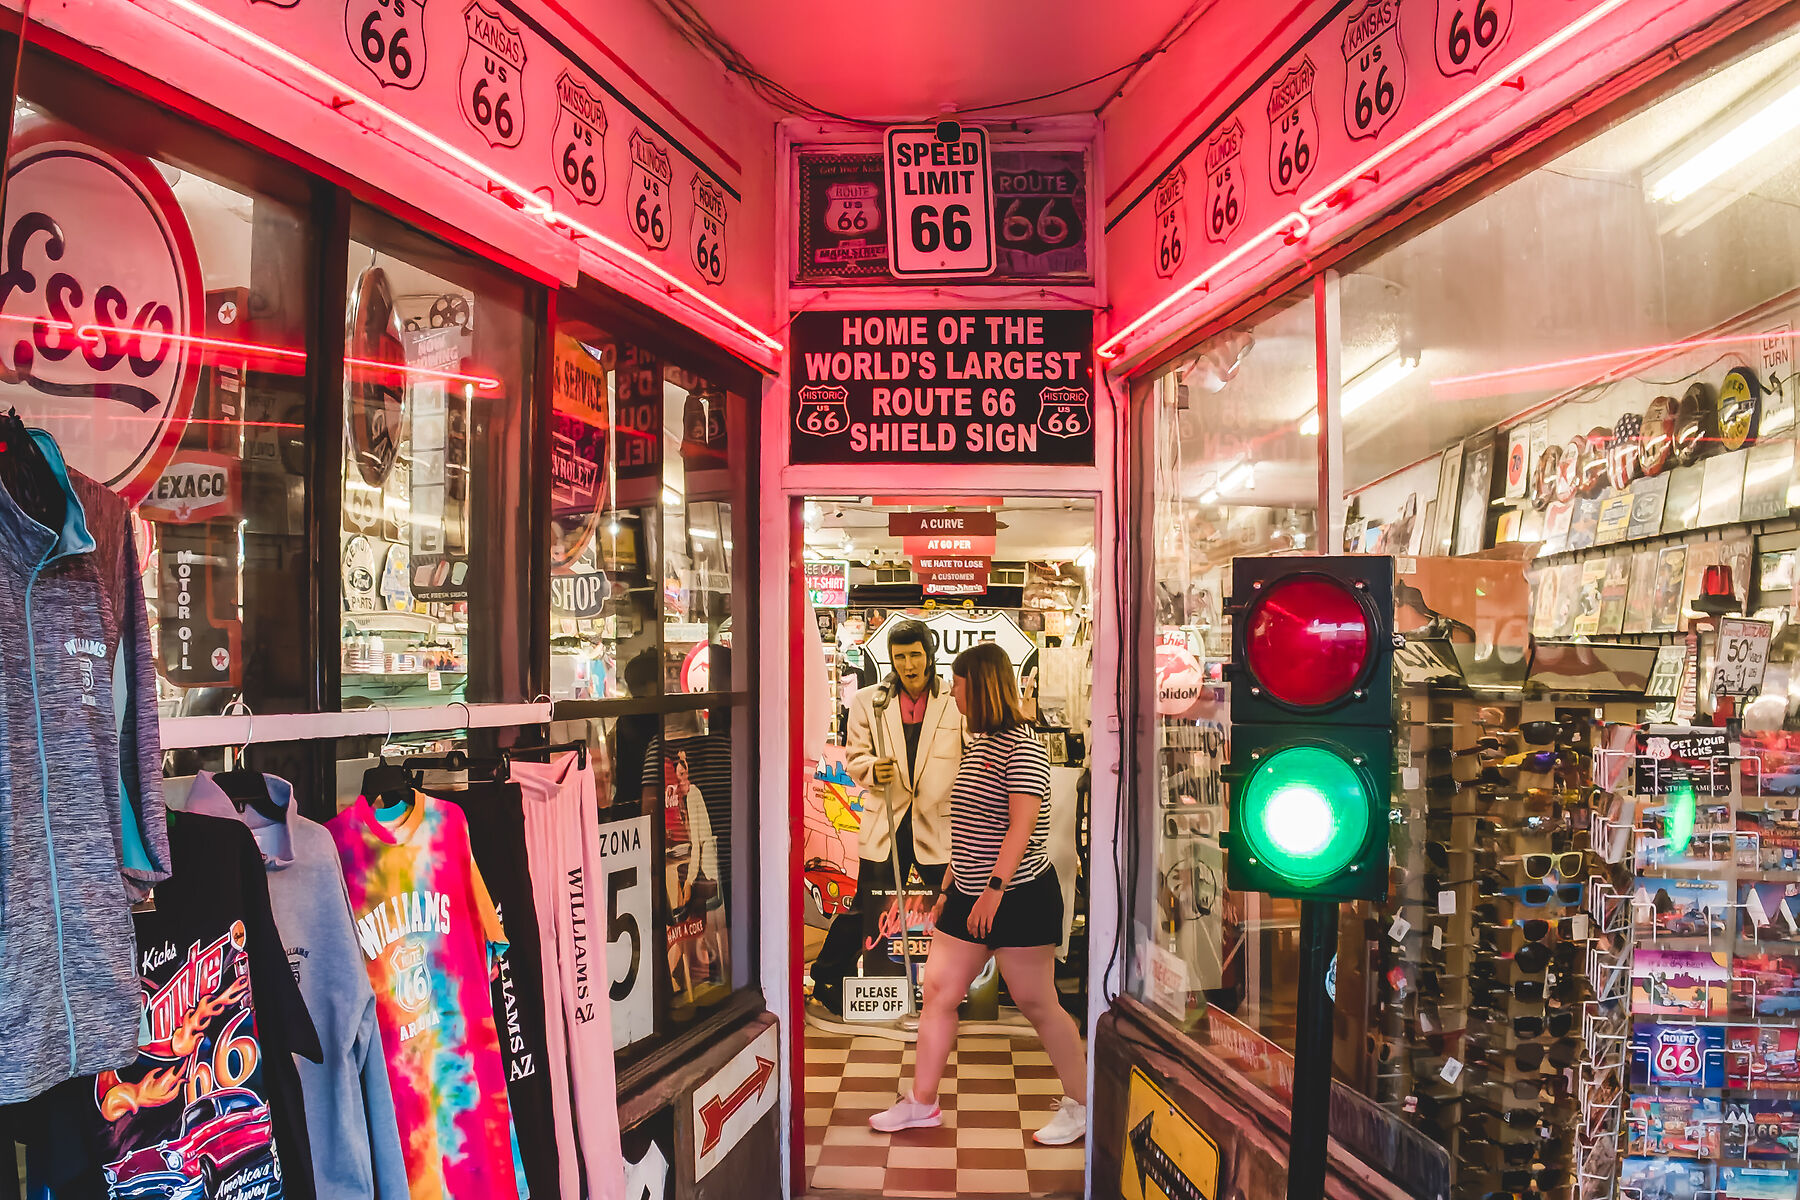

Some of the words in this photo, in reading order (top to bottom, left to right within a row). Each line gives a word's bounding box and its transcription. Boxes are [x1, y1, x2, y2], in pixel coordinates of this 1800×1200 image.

[1348, 1, 1392, 48] KANSAS
[1449, 0, 1498, 65] 66
[361, 10, 412, 79] 66
[474, 15, 519, 63] KANSAS
[484, 55, 507, 83] US
[1360, 44, 1382, 72] US
[1272, 67, 1310, 114] MISSOURI
[1355, 65, 1394, 130] 66
[472, 78, 513, 139] 66
[563, 82, 604, 129] MISSOURI
[573, 122, 593, 147] US
[1281, 109, 1299, 134] US
[636, 142, 668, 179] ILLINOIS
[896, 141, 979, 168] SPEED
[1209, 133, 1237, 169] ILLINOIS
[1278, 128, 1310, 186] 66
[562, 142, 597, 196] 66
[904, 170, 975, 195] LIMIT
[1000, 174, 1068, 192] ROUTE
[1216, 167, 1231, 188] US
[643, 175, 660, 197] US
[835, 186, 870, 197] ROUTE
[1159, 179, 1180, 210] ROUTE
[699, 191, 722, 217] ROUTE
[843, 201, 863, 209] US
[1212, 183, 1238, 235] 66
[635, 194, 664, 243] 66
[703, 217, 717, 236] US
[837, 211, 868, 230] 66
[910, 204, 973, 253] 66
[1002, 199, 1069, 244] 66
[1163, 210, 1175, 228] US
[697, 233, 721, 278] 66
[1160, 226, 1181, 271] 66
[842, 316, 928, 346] HOME
[937, 316, 976, 345] OF
[985, 316, 1044, 345] THE
[804, 352, 936, 381] WORLD'S
[946, 351, 1082, 381] LARGEST
[1762, 349, 1789, 369] TURN
[563, 358, 602, 413] SERVICE
[802, 390, 844, 400] HISTORIC
[1043, 391, 1086, 402] HISTORIC
[816, 404, 830, 412] US
[872, 388, 972, 417] ROUTE
[981, 387, 1017, 416] 66
[806, 411, 840, 432] 66
[1047, 413, 1081, 431] 66
[849, 422, 957, 453] SHIELD
[966, 422, 1038, 453] SIGN
[149, 472, 225, 500] EXACO
[920, 519, 928, 529] A
[930, 518, 964, 529] CURVE
[927, 540, 939, 549] AT
[940, 540, 953, 549] 60
[954, 540, 971, 549] PER
[820, 564, 840, 574] CAP
[920, 559, 933, 568] WE
[934, 559, 953, 568] HATE
[954, 559, 963, 567] TO
[964, 559, 983, 568] LOSE
[177, 550, 192, 619] MOTOR
[551, 576, 601, 611] SHOP
[811, 577, 845, 589] T-SHIRT
[351, 596, 373, 610] PARTS
[178, 626, 192, 671] OIL
[1670, 739, 1692, 750] GET
[1696, 736, 1725, 747] YOUR
[1679, 747, 1713, 758] KICKS
[1641, 785, 1662, 793] MAN
[600, 827, 641, 858] ZONA
[357, 890, 451, 961] WILLIAMS
[567, 866, 589, 1000] WILLIAMS
[606, 866, 641, 1002] 5
[666, 927, 684, 945] HAVE
[689, 919, 704, 938] COKE
[142, 941, 178, 976] Kicks
[141, 938, 230, 1043] oute
[403, 965, 428, 1006] 66
[855, 986, 898, 998] PLEASE
[575, 1002, 595, 1026] AZ
[850, 1000, 879, 1011] KEEP
[882, 1000, 904, 1011] OFF
[1662, 1033, 1695, 1044] ROUTE
[185, 1007, 260, 1105] 66
[509, 1053, 535, 1082] AZ
[1660, 1047, 1696, 1072] 66
[1757, 1124, 1779, 1137] 66
